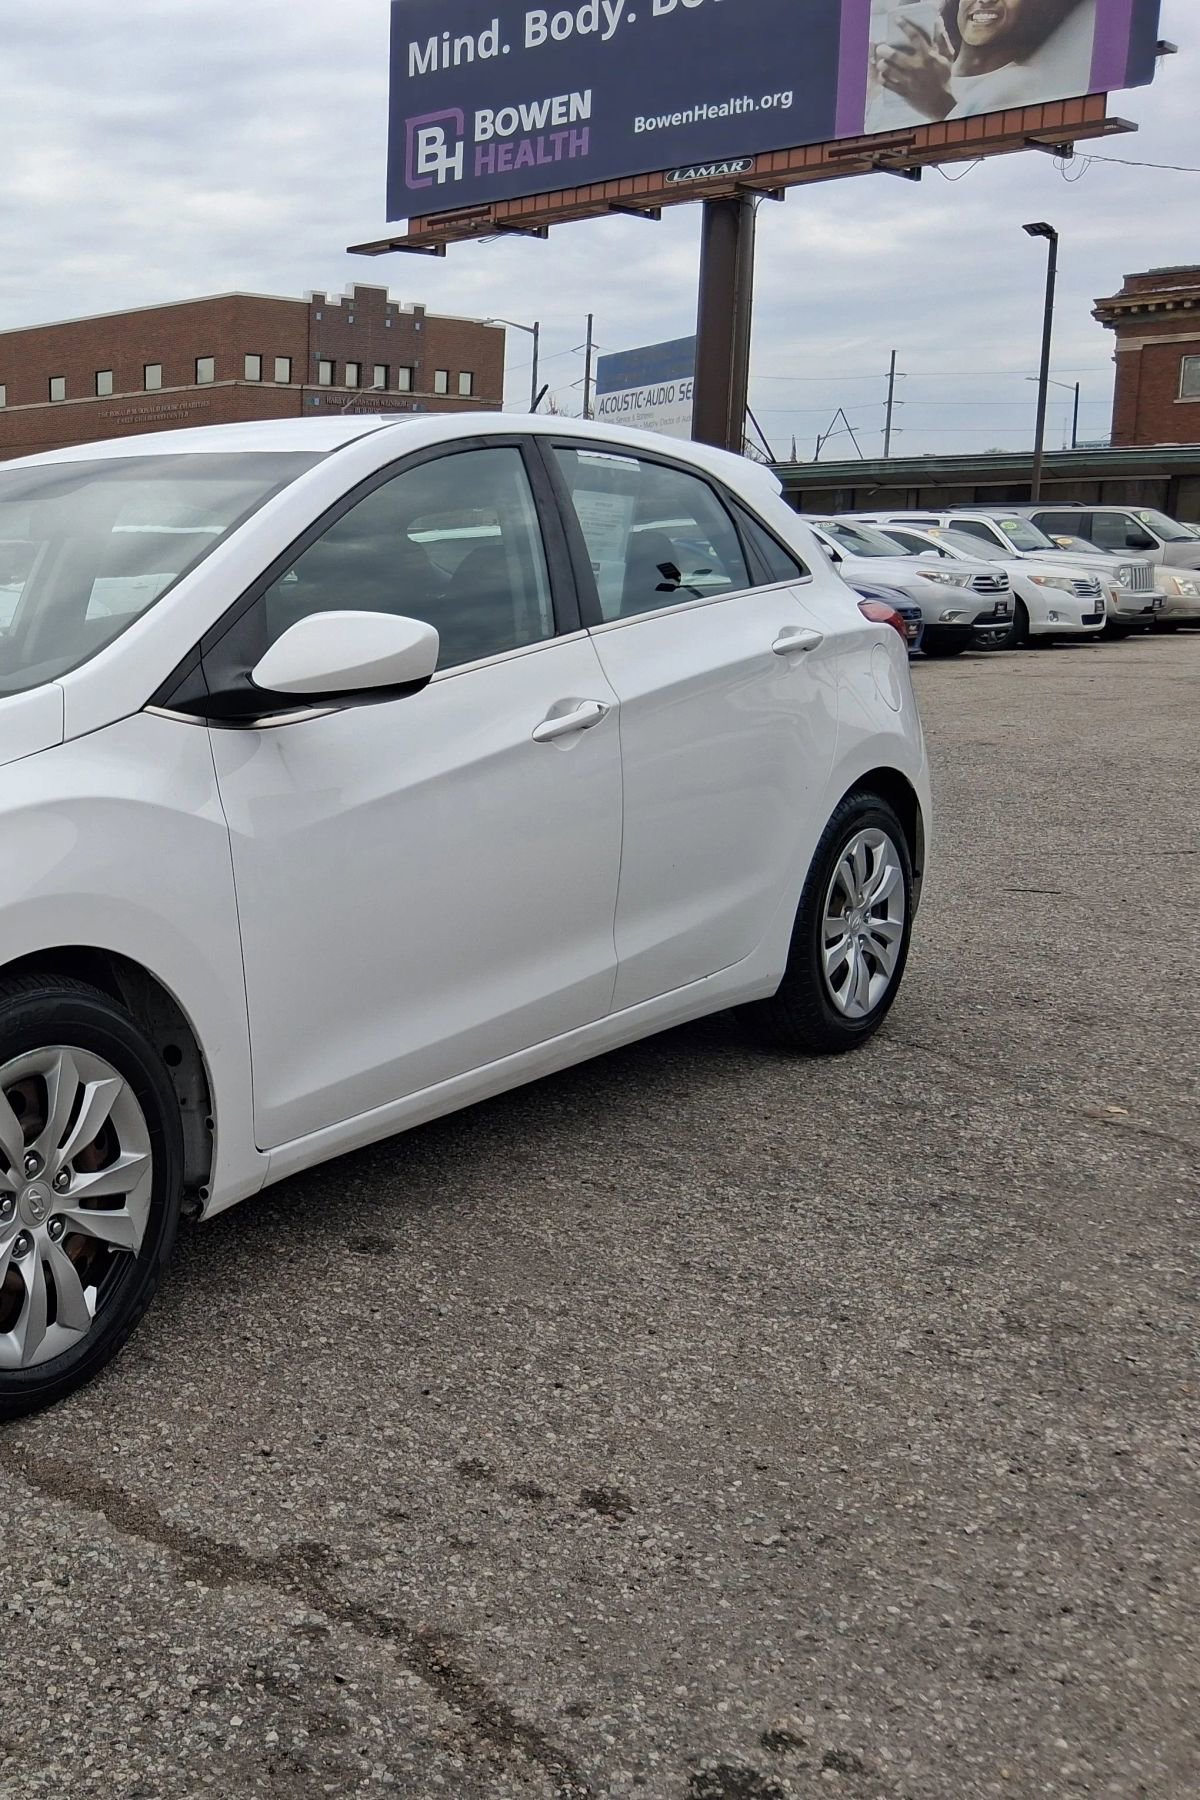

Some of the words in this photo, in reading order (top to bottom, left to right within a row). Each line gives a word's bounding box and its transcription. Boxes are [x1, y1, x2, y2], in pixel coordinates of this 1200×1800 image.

[408, 18, 510, 77] Mind.
[525, 0, 637, 49] Body.
[474, 89, 592, 141] BOWEN
[634, 90, 793, 133] BowenHealth.org
[475, 126, 590, 176] HEALTH
[673, 160, 745, 181] LAMAR
[679, 382, 693, 401] SE
